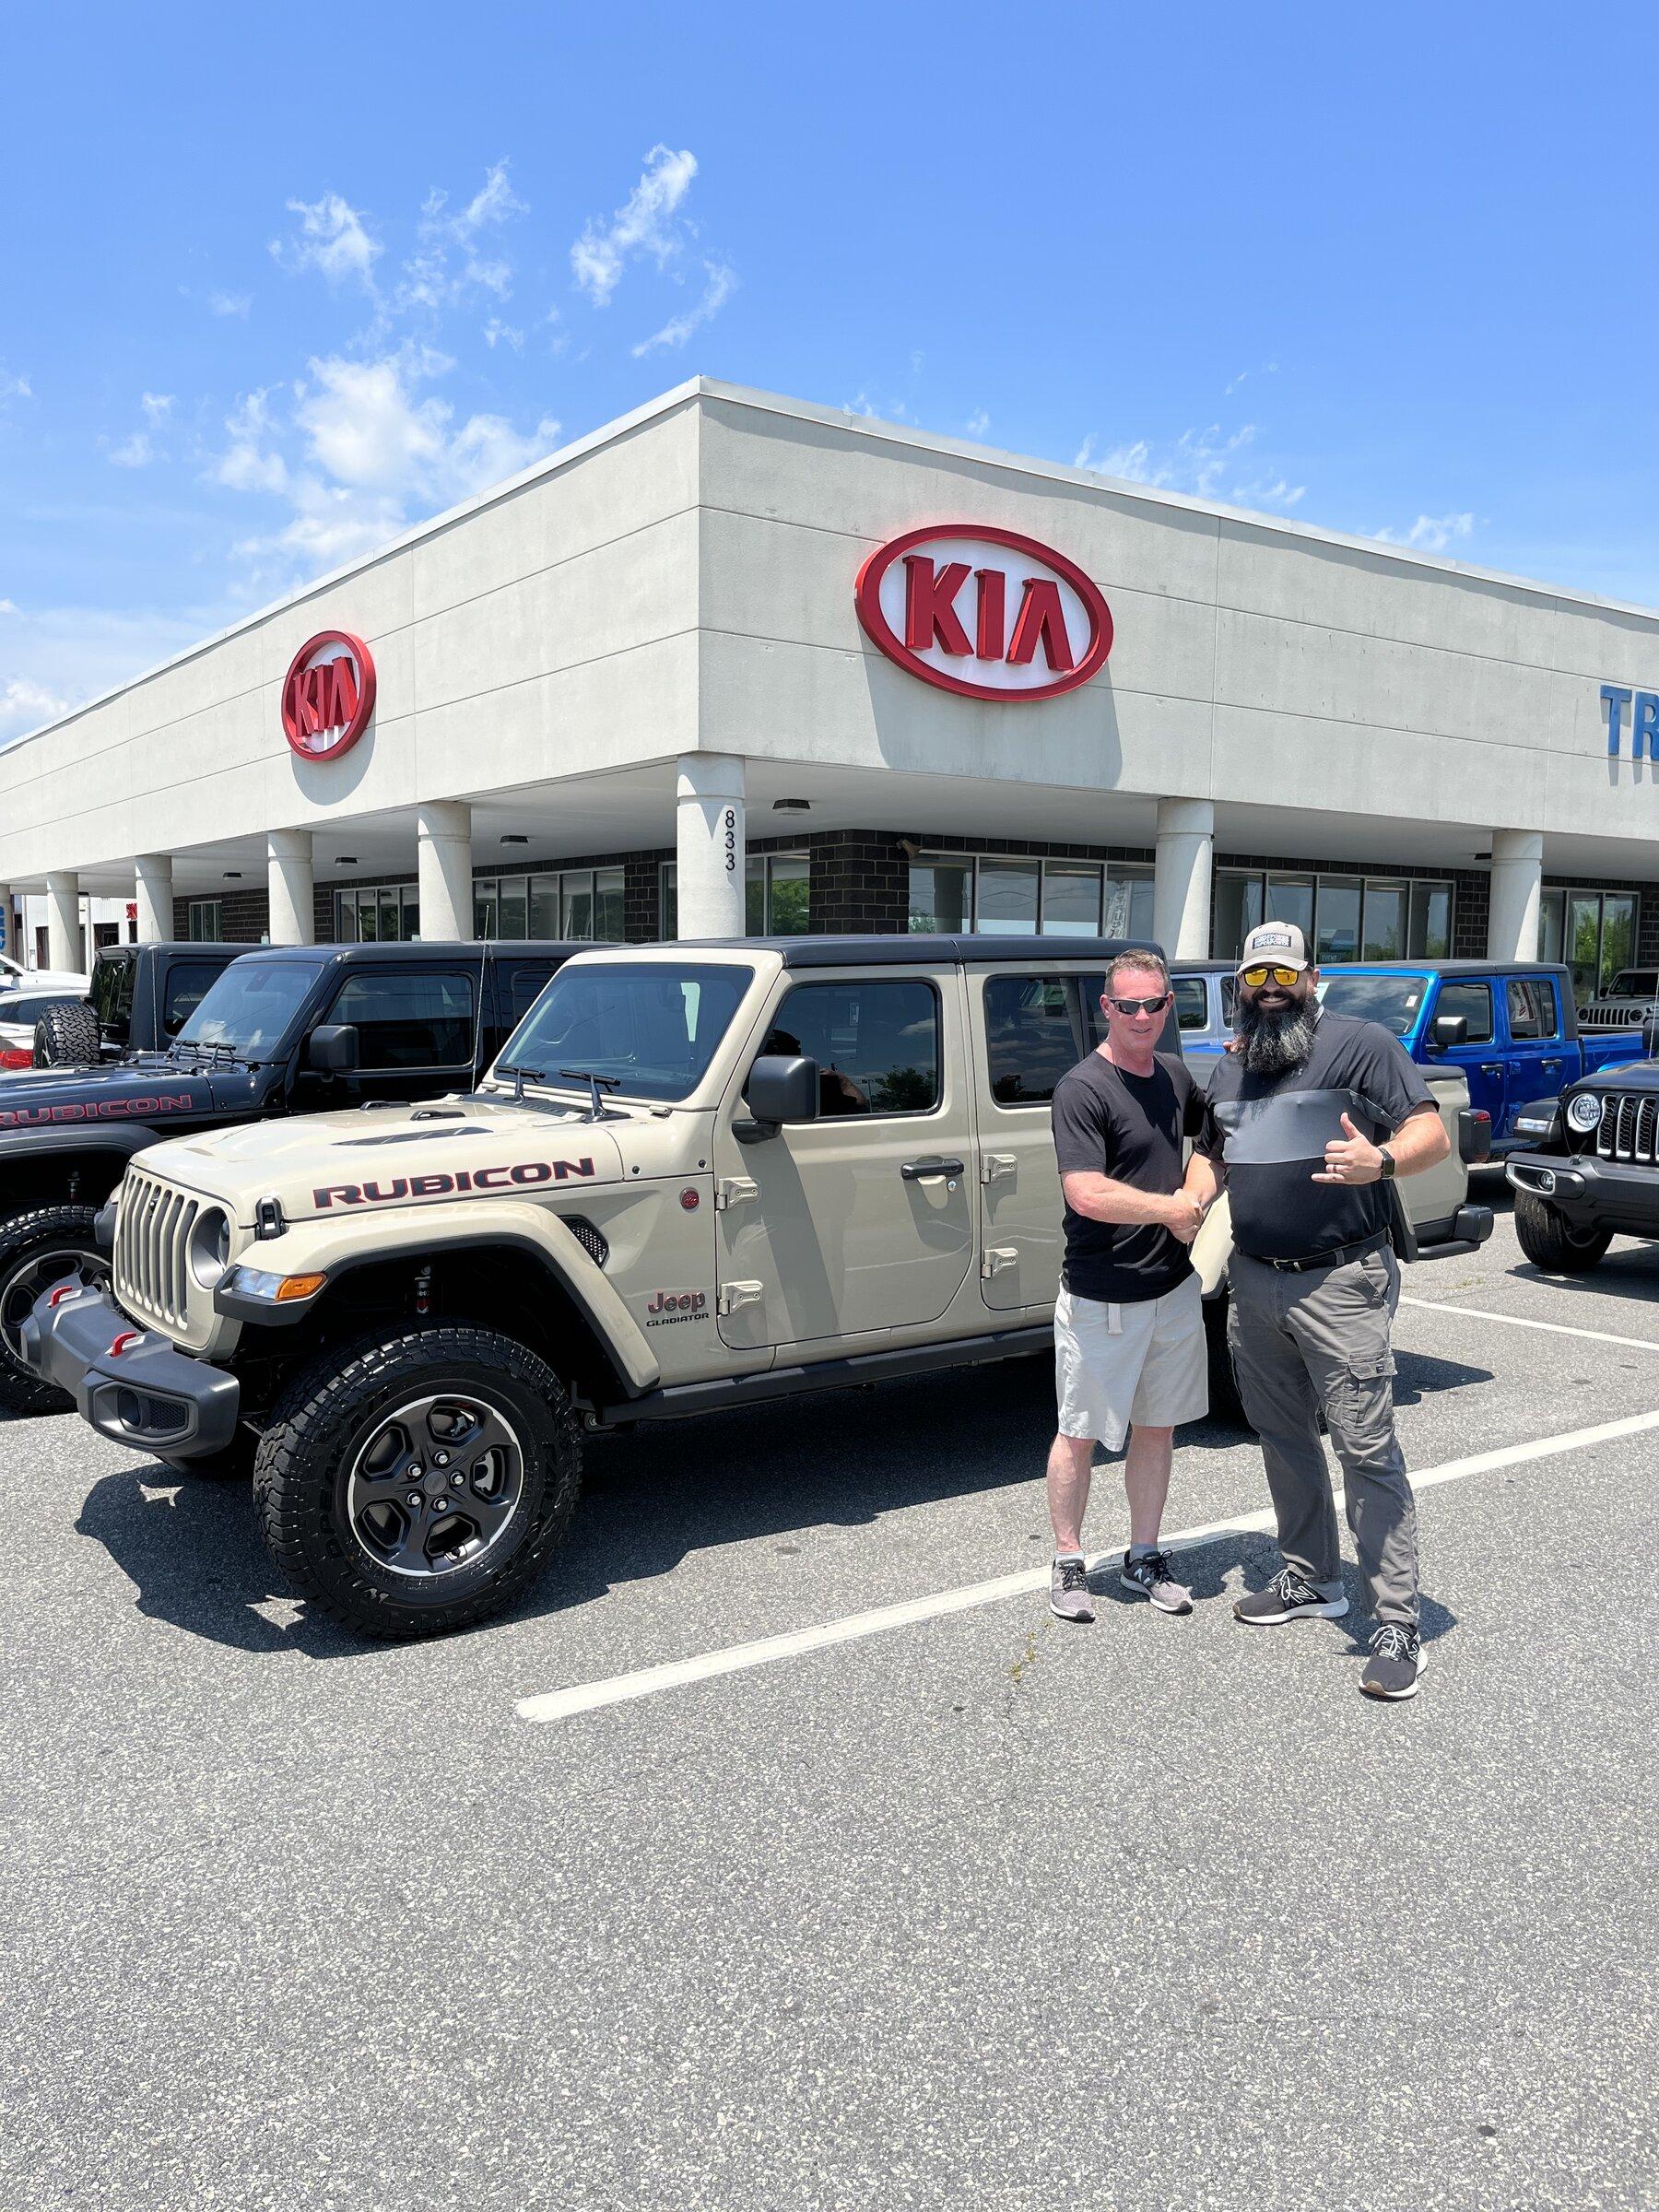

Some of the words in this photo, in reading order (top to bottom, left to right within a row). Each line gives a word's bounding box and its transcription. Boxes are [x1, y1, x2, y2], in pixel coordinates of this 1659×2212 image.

[902, 555, 1075, 671] KIA
[293, 657, 359, 737] KIA
[1600, 684, 1659, 761] TR
[724, 810, 735, 871] 833
[312, 1157, 595, 1209] RUBICON
[646, 1312, 710, 1327] GLADIATOR
[648, 1292, 706, 1313] Jeep
